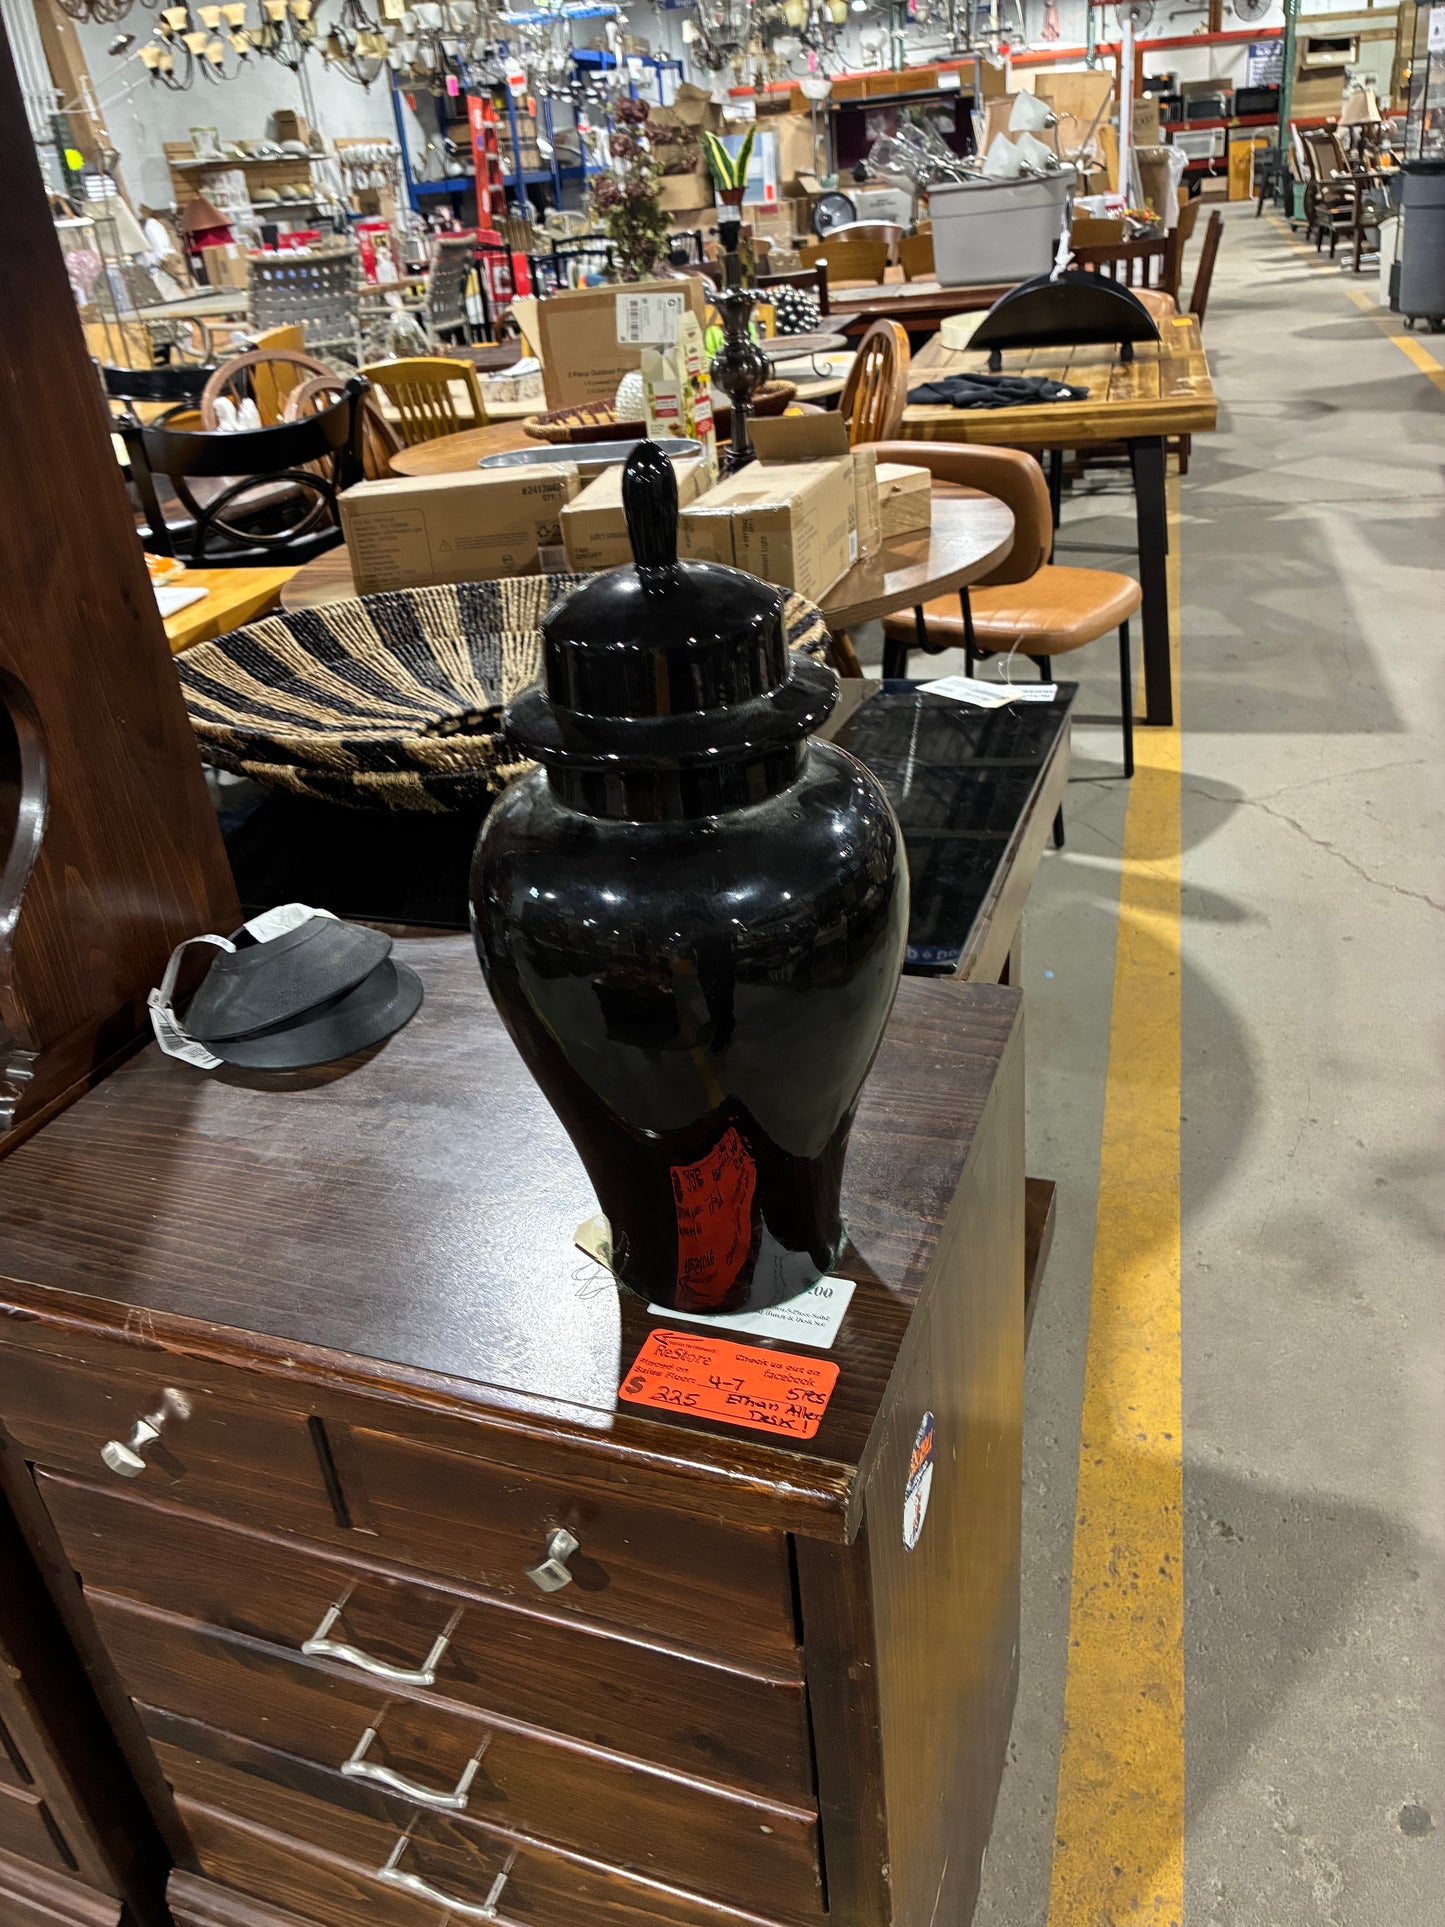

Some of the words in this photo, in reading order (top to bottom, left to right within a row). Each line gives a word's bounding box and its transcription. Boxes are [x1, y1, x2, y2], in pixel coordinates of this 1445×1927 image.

[654, 1344, 712, 1366] ReStore
[735, 1354, 769, 1367] Check
[770, 1361, 783, 1369] us
[786, 1363, 805, 1374] out
[807, 1369, 821, 1377] on
[708, 1374, 745, 1392] 4-7
[763, 1369, 817, 1388] facebook
[625, 1375, 647, 1396] $
[652, 1385, 701, 1407] 225
